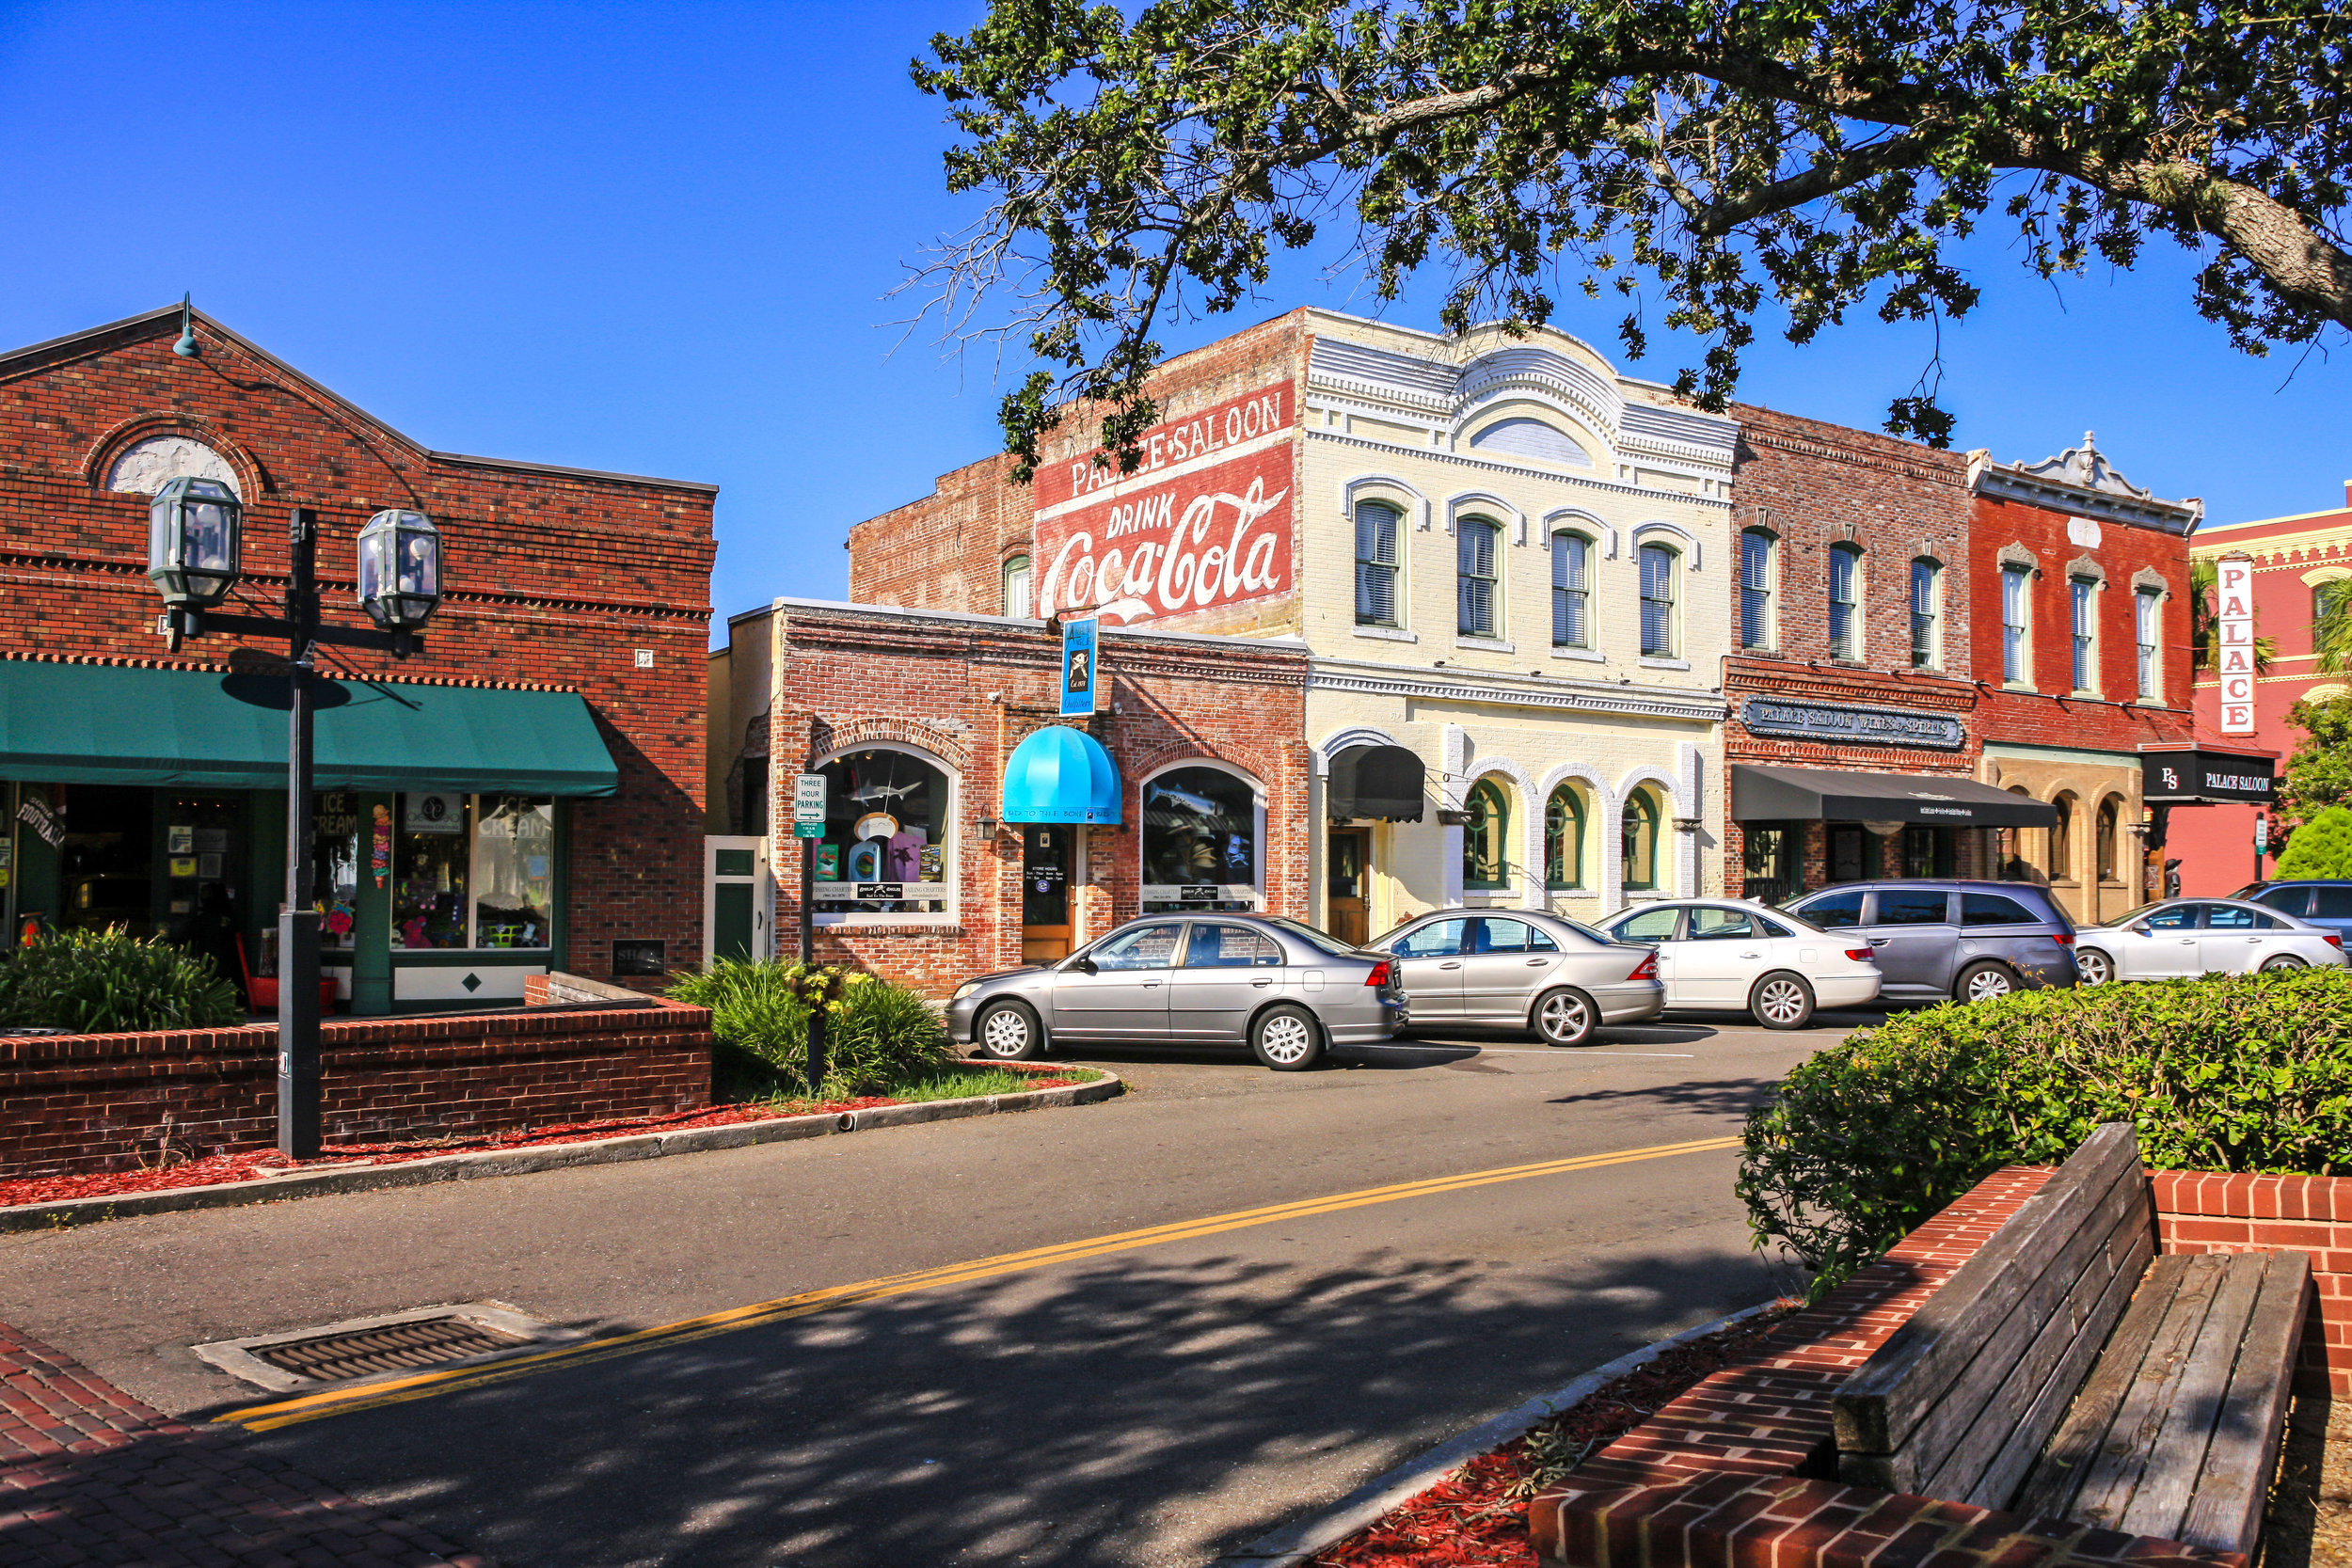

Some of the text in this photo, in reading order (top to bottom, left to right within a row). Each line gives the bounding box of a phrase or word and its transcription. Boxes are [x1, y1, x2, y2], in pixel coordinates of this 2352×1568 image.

[1072, 391, 1282, 498] PALCE SALOON
[1104, 492, 1177, 541] DRINK
[1040, 475, 1290, 620] Coca-Cola
[2223, 569, 2249, 725] PALACE
[1760, 707, 1805, 725] PALACE
[1807, 710, 1853, 728] SALOON
[2206, 772, 2270, 792] PALACE SALOON
[323, 794, 345, 813] ICE
[797, 800, 824, 809] PARKING
